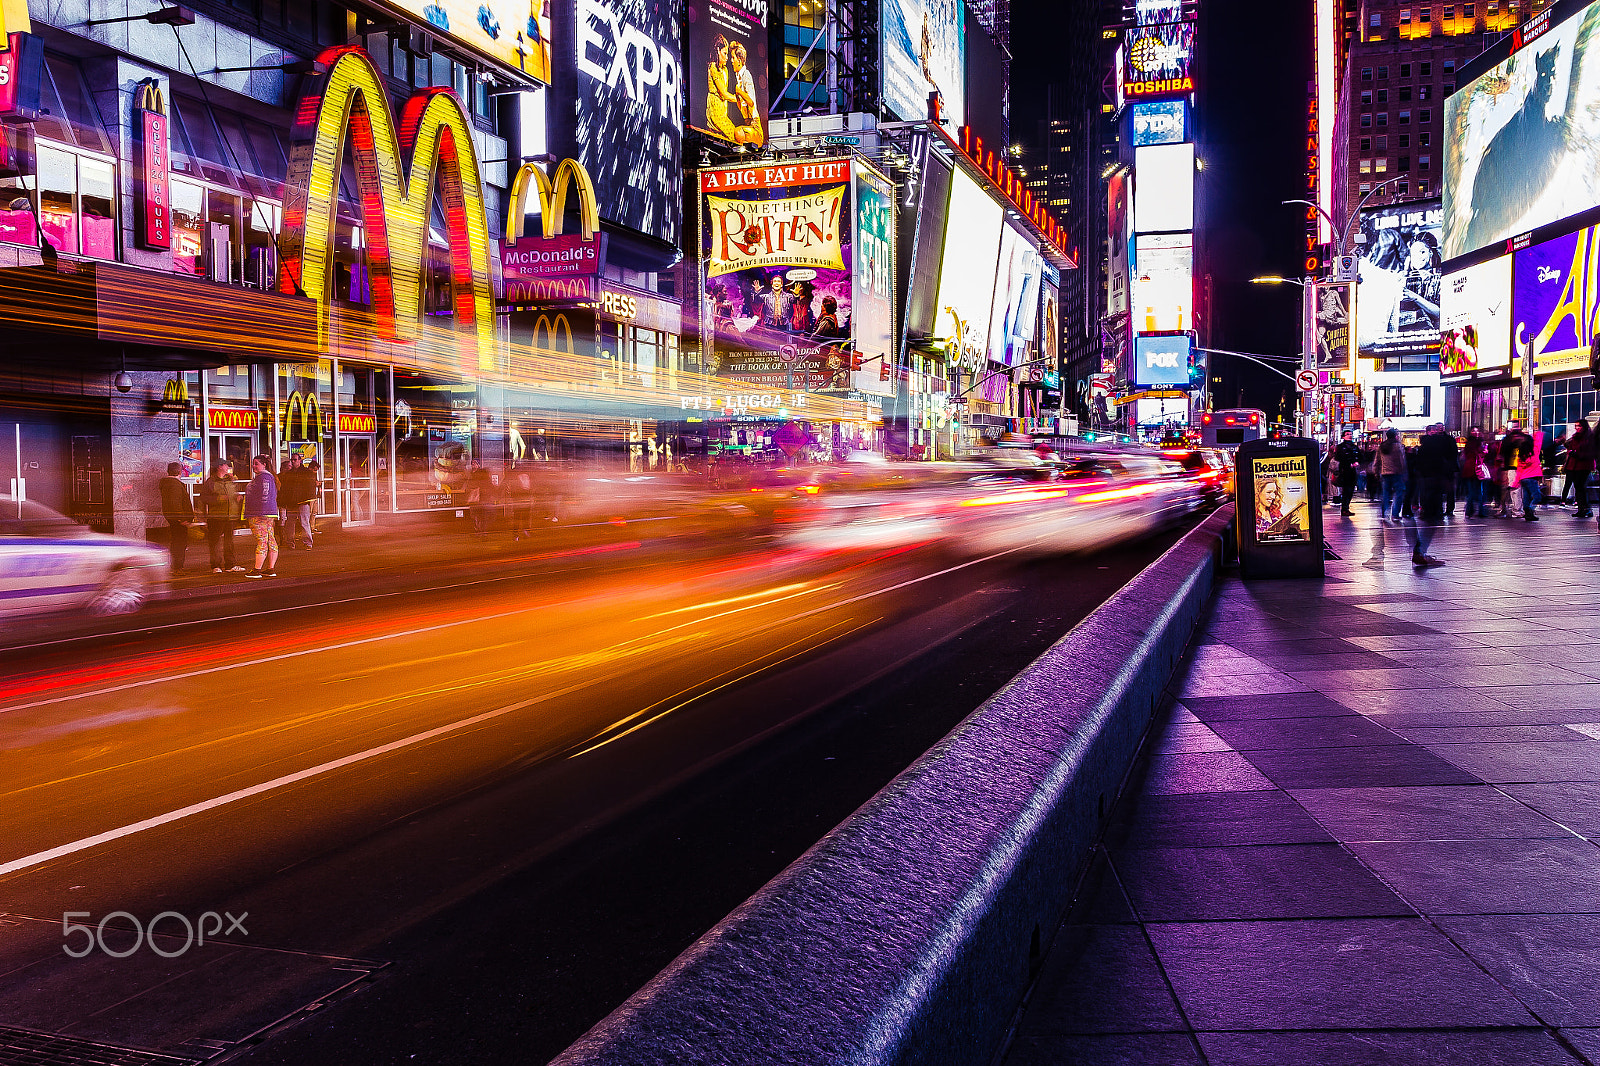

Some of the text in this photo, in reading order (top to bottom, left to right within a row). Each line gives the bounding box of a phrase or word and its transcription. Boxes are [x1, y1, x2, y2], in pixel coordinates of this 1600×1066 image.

[1523, 8, 1553, 33] MARRIOTT
[1523, 21, 1548, 44] MARQUIS
[577, 0, 683, 130] EXPR
[1124, 77, 1193, 95] TOSHIBA
[827, 136, 858, 144] LAMAR
[151, 120, 164, 240] OPEN 24 HOURS
[725, 170, 759, 187] BIG,
[764, 167, 797, 183] FAT
[1306, 100, 1318, 270] ERNST & YO
[964, 125, 1067, 252] 1540 BROADWAY
[727, 195, 825, 213] SOMETHING
[504, 245, 595, 265] McDonald's
[862, 228, 889, 298] STAR
[520, 262, 580, 274] Restaurant
[720, 256, 834, 273] BROADWAY'S HILARIOUS NEW SMASH!
[594, 291, 637, 318] RESS
[796, 347, 821, 356] ADDIN
[1329, 336, 1348, 352] ALONG
[748, 362, 770, 371] BOOK
[772, 362, 783, 370] OF
[1146, 351, 1179, 368] FOX
[726, 394, 806, 409] LUGGAE
[1254, 459, 1306, 473] Beautiful
